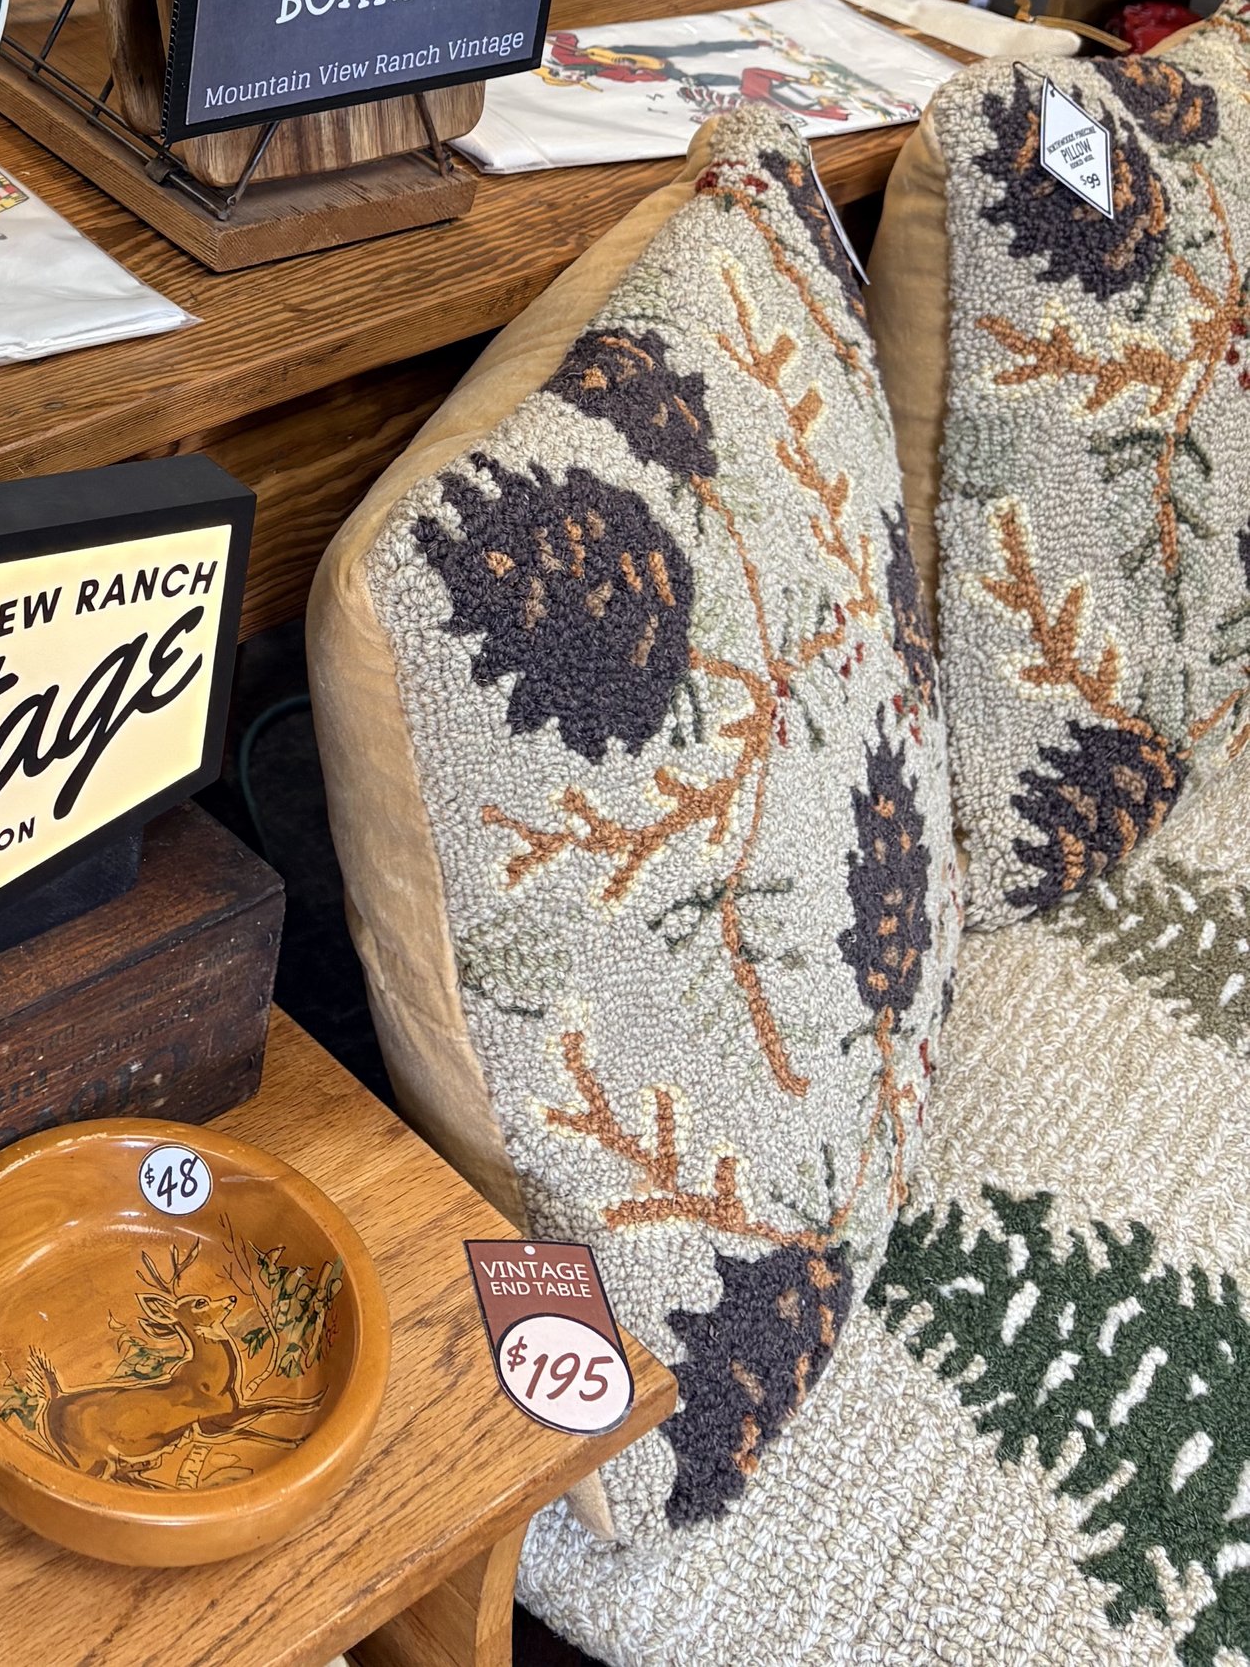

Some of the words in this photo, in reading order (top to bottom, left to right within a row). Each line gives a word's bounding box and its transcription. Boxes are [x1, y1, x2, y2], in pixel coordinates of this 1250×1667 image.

[204, 70, 312, 109] Mountain
[318, 60, 369, 85] View
[373, 44, 440, 76] Ranch
[447, 31, 525, 62] Vintage
[1060, 138, 1092, 164] PILLOW
[1080, 172, 1101, 189] $99
[74, 560, 218, 616] RANCH
[144, 1155, 200, 1208] $48
[480, 1260, 590, 1281] VINTAGE
[490, 1281, 530, 1296] END
[533, 1281, 592, 1298] TABLE
[507, 1335, 614, 1402] $195
